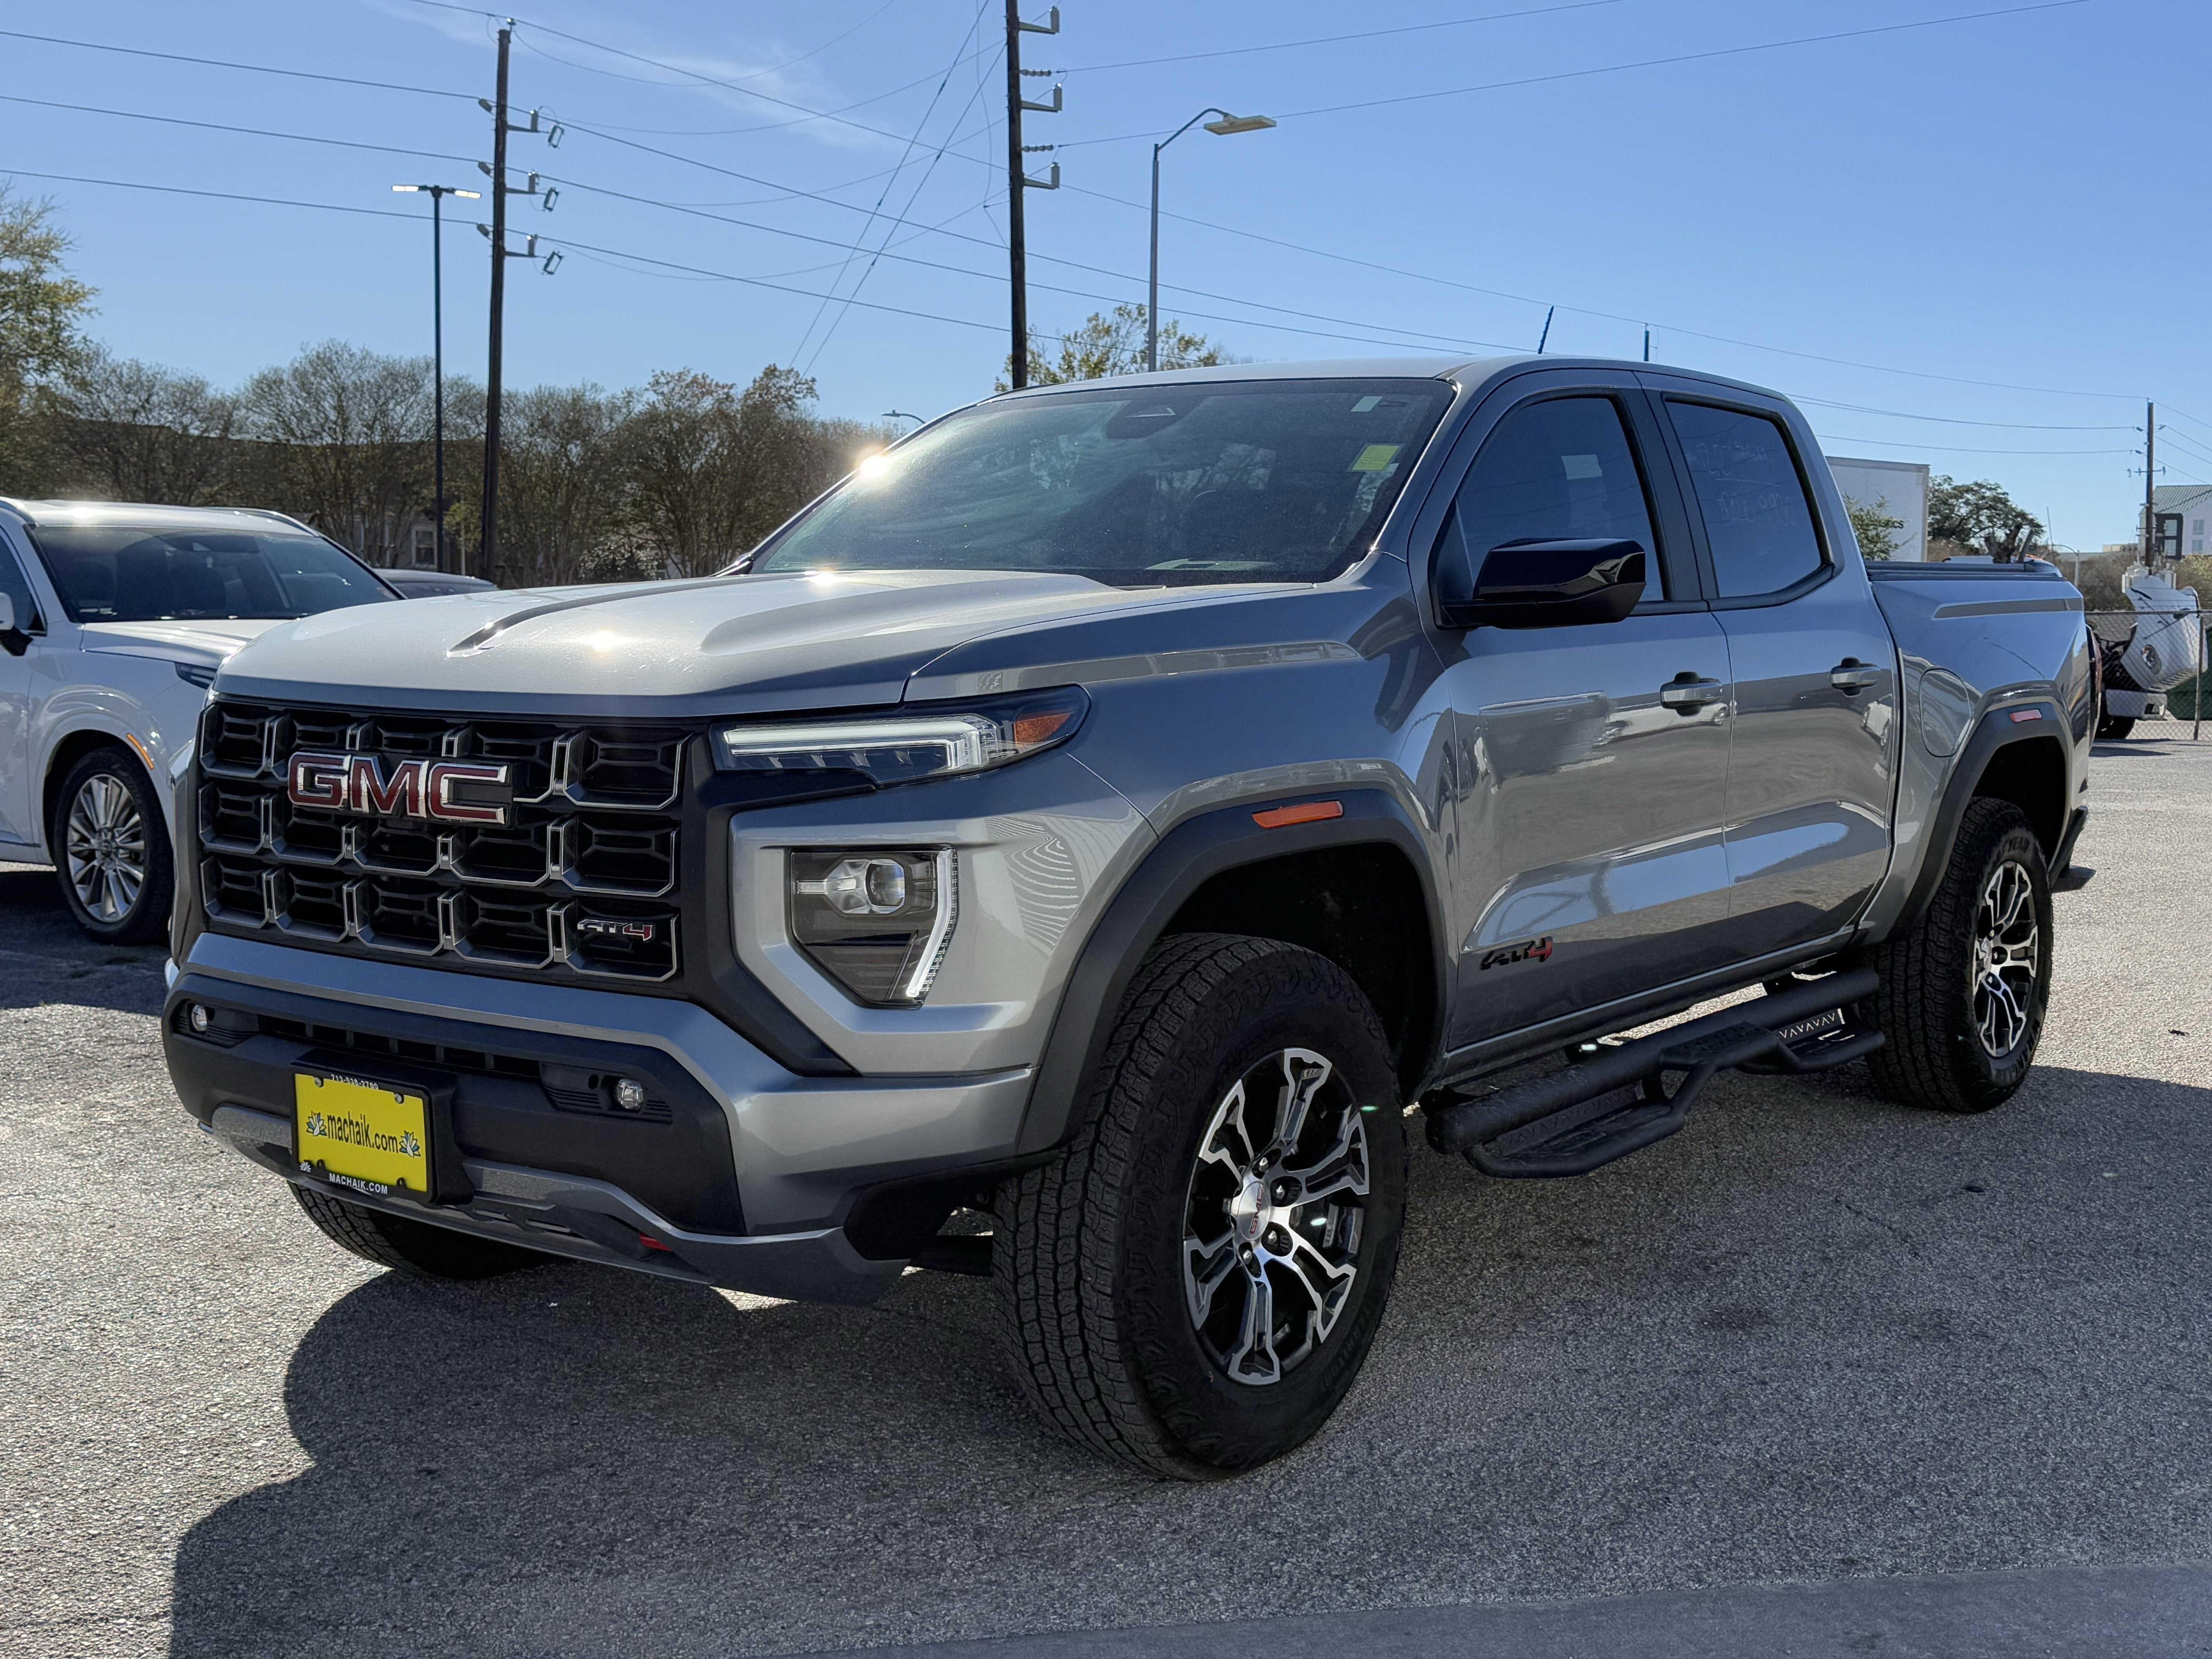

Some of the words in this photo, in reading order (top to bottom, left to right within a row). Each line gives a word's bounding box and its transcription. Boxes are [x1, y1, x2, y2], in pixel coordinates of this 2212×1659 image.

[288, 752, 507, 824] GMC
[577, 919, 652, 941] AT4
[1480, 936, 1553, 970] AT4
[327, 1111, 398, 1153] machaik.com
[329, 1172, 388, 1194] MACHAIK.COM
[1249, 1184, 1263, 1234] GMC
